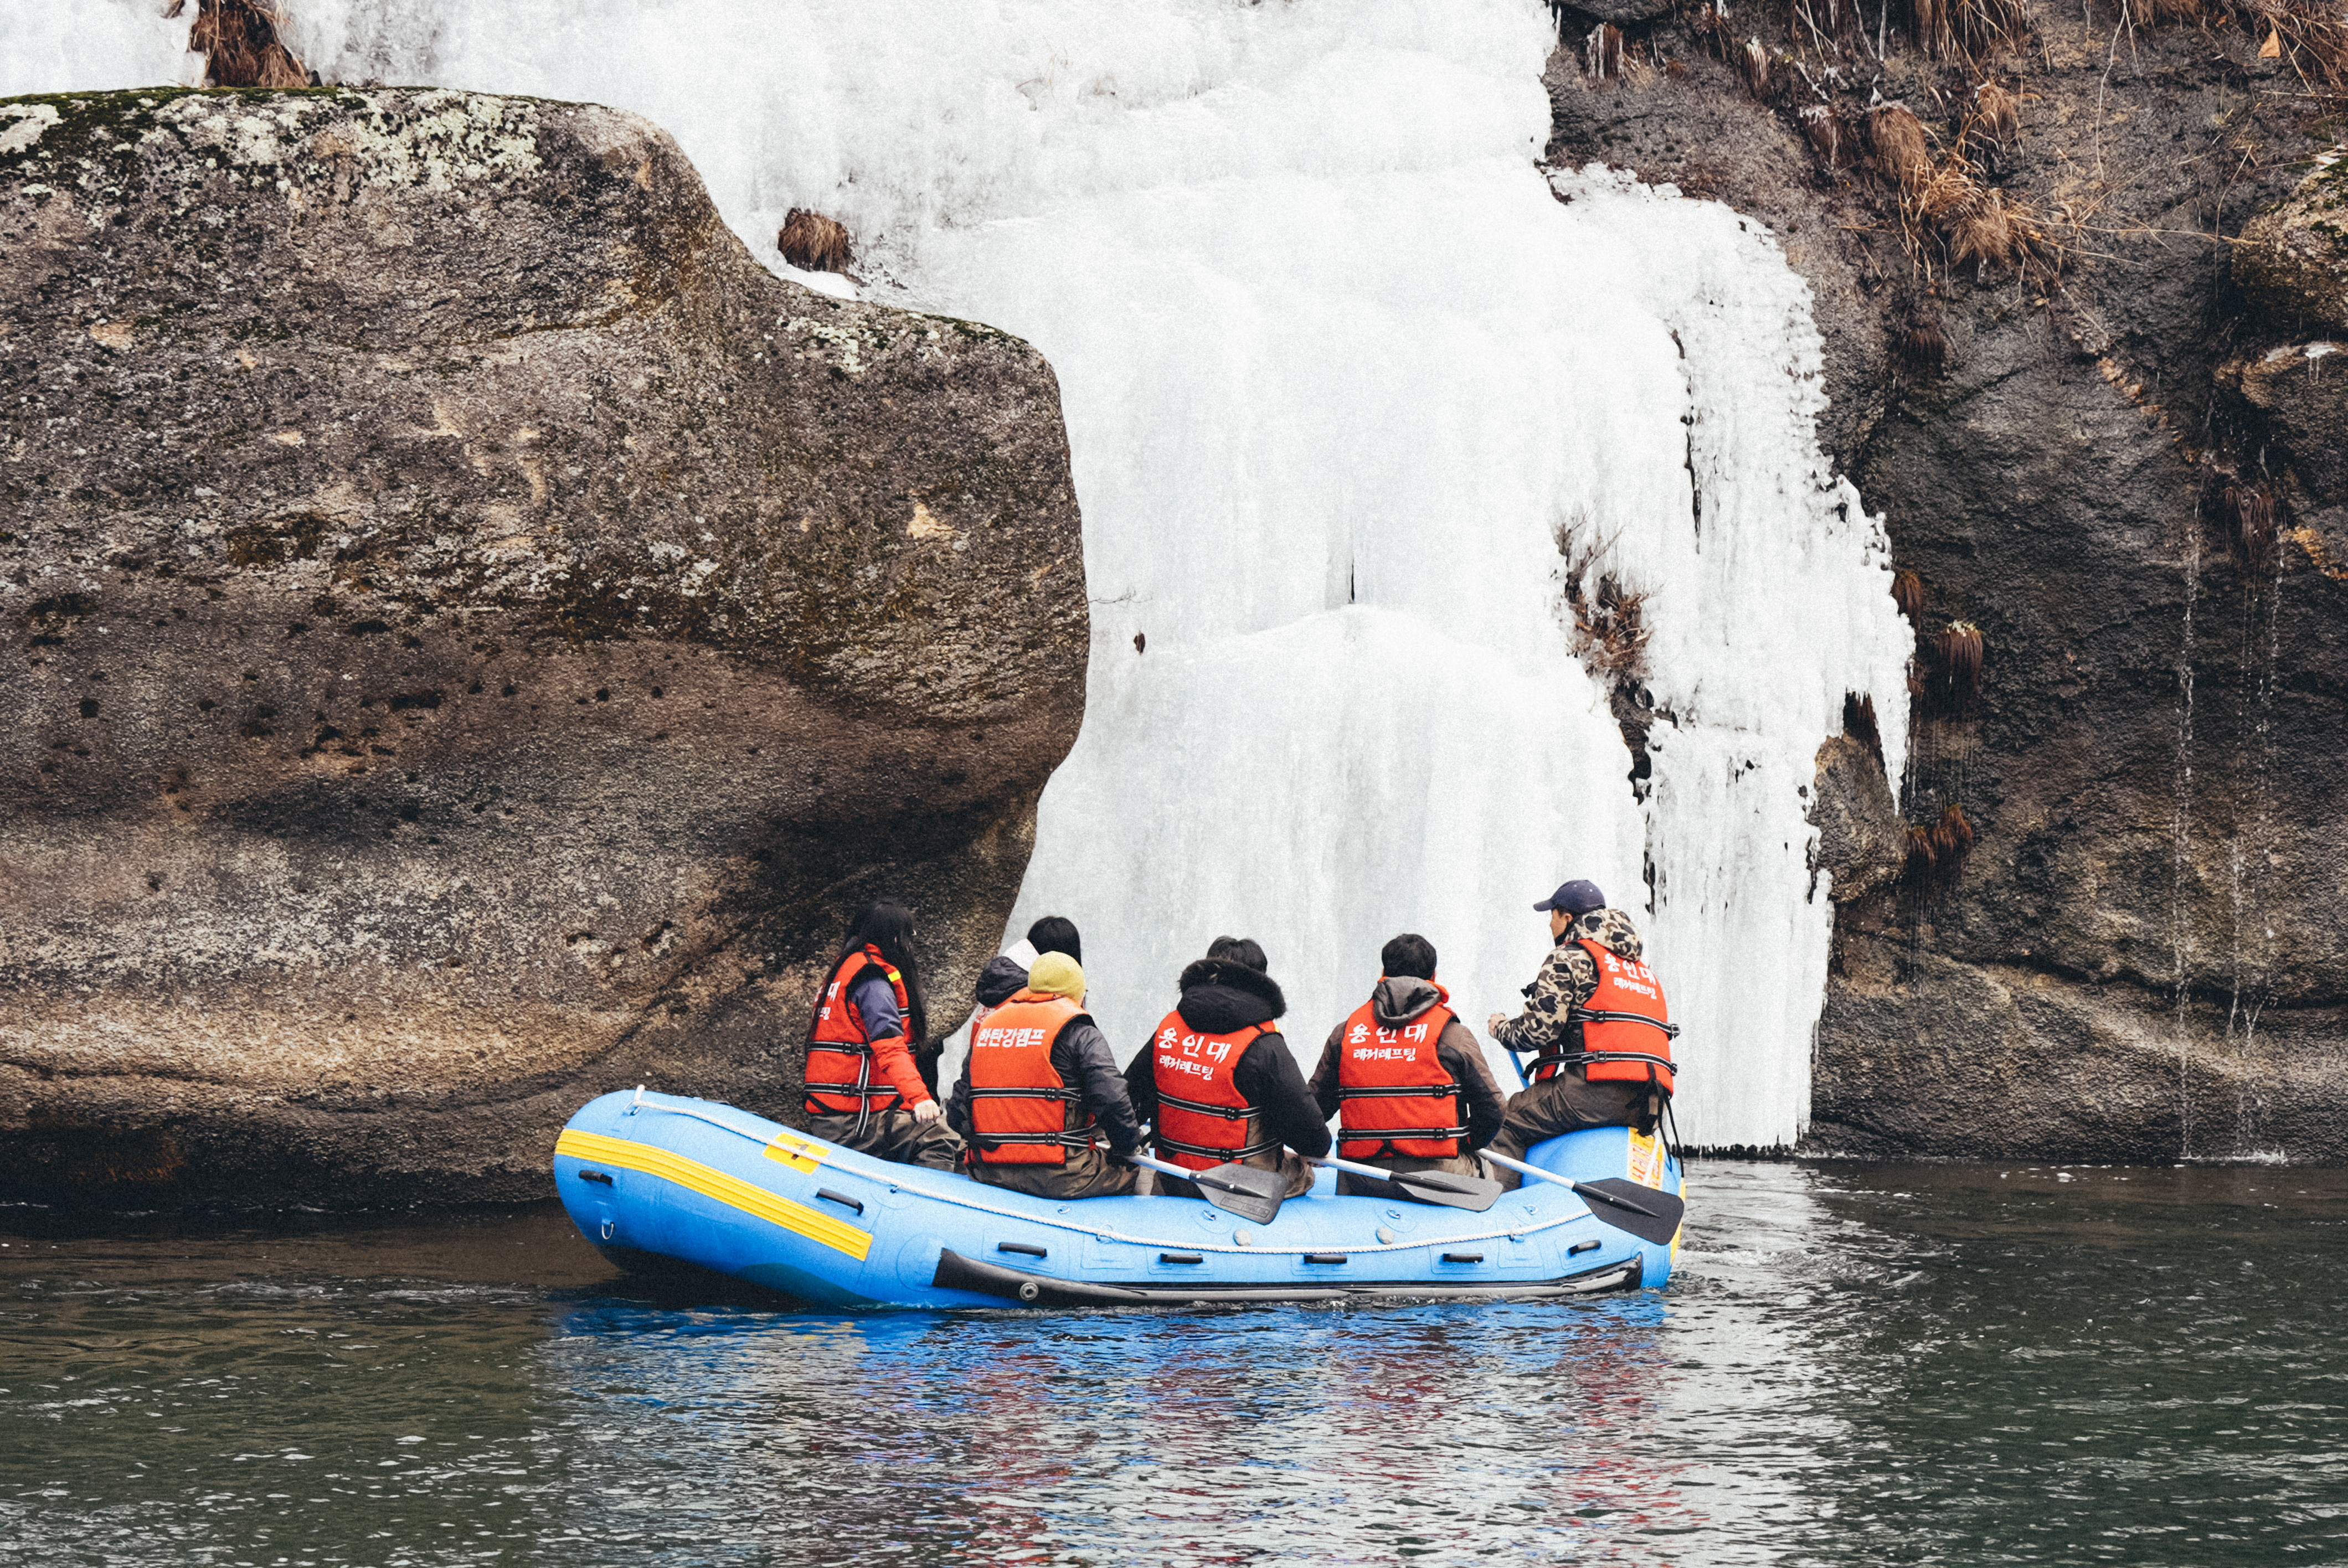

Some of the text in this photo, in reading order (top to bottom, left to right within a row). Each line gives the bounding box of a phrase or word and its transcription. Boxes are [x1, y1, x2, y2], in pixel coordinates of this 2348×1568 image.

[1604, 952, 1656, 985] 용인대
[976, 1028, 1046, 1048] 한탄강캠프
[1158, 1027, 1232, 1064] 용인대
[1348, 1023, 1428, 1044] 용인대
